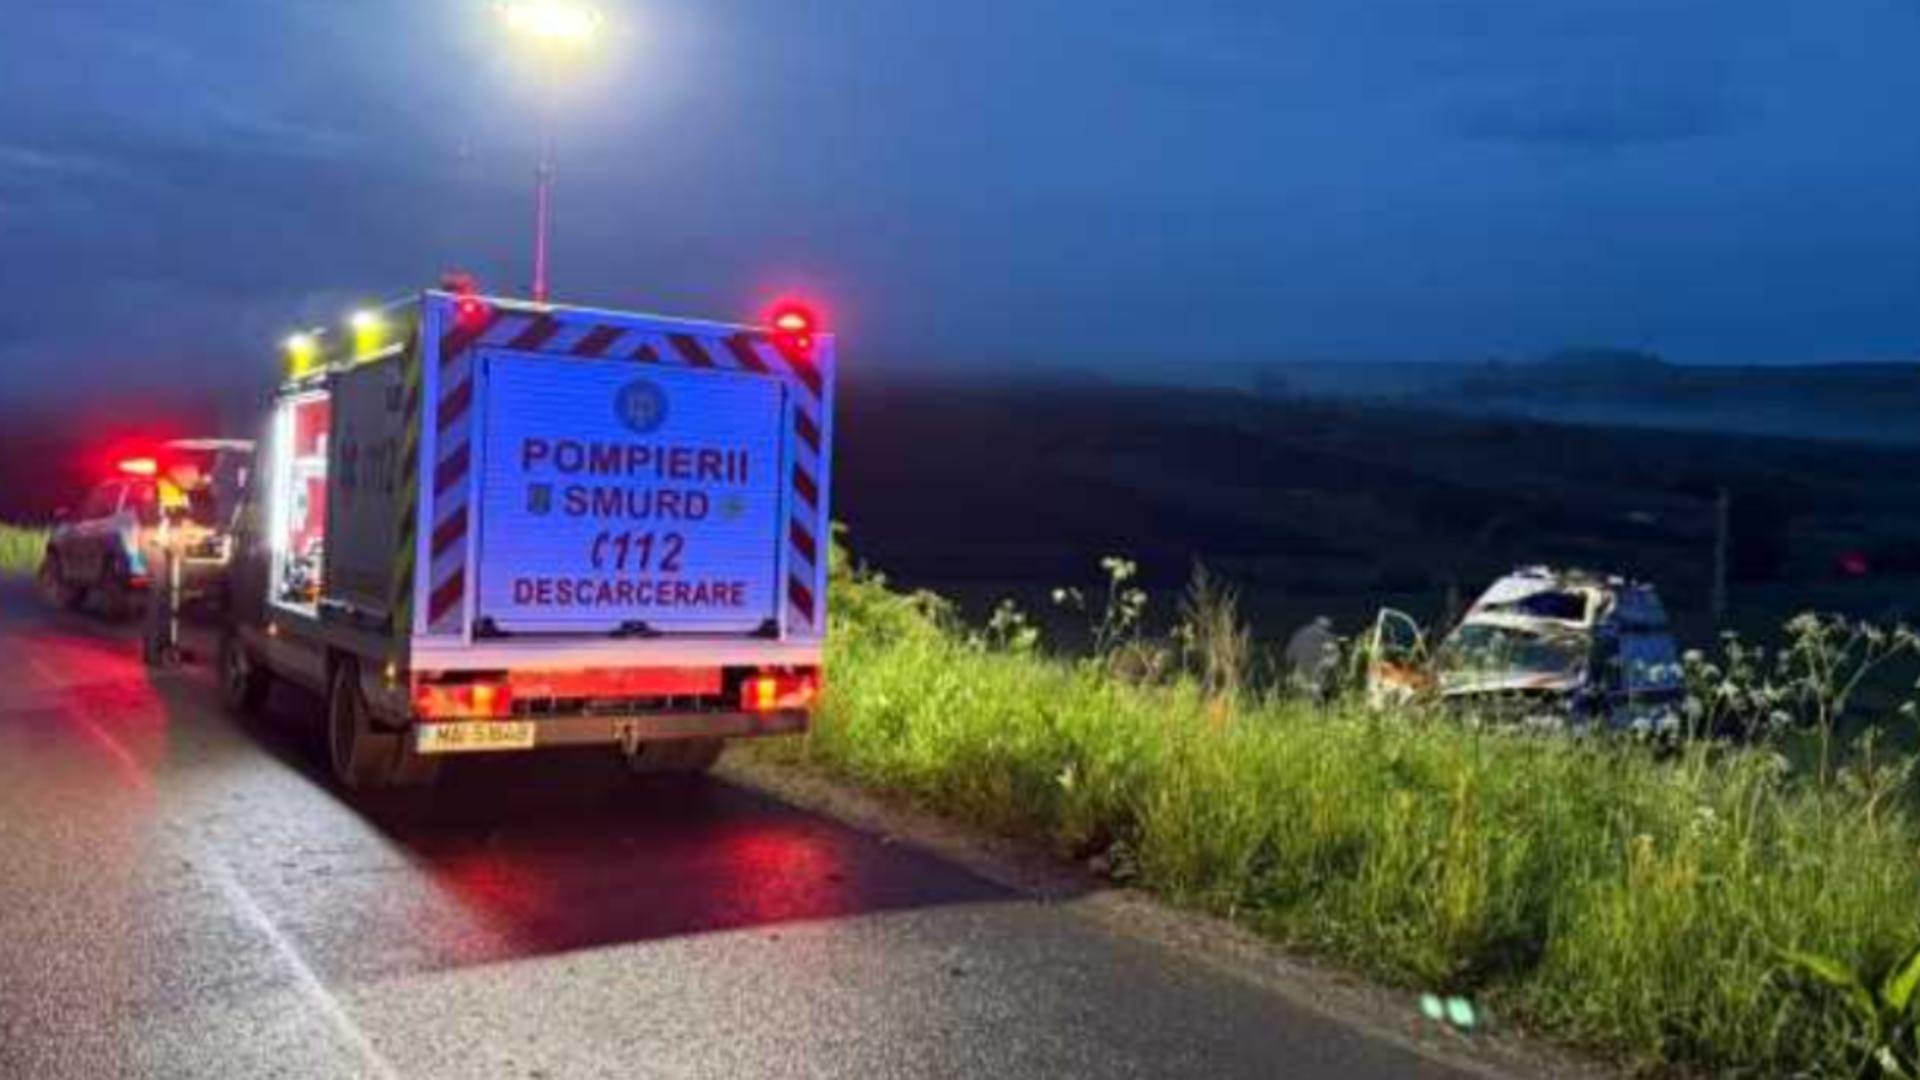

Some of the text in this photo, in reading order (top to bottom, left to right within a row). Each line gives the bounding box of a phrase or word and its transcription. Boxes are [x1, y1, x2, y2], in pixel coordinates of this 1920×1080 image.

[522, 437, 748, 485] POMPIERII
[564, 484, 710, 520] SMURD
[611, 531, 685, 572] 112
[513, 578, 746, 606] DESCARCERARE
